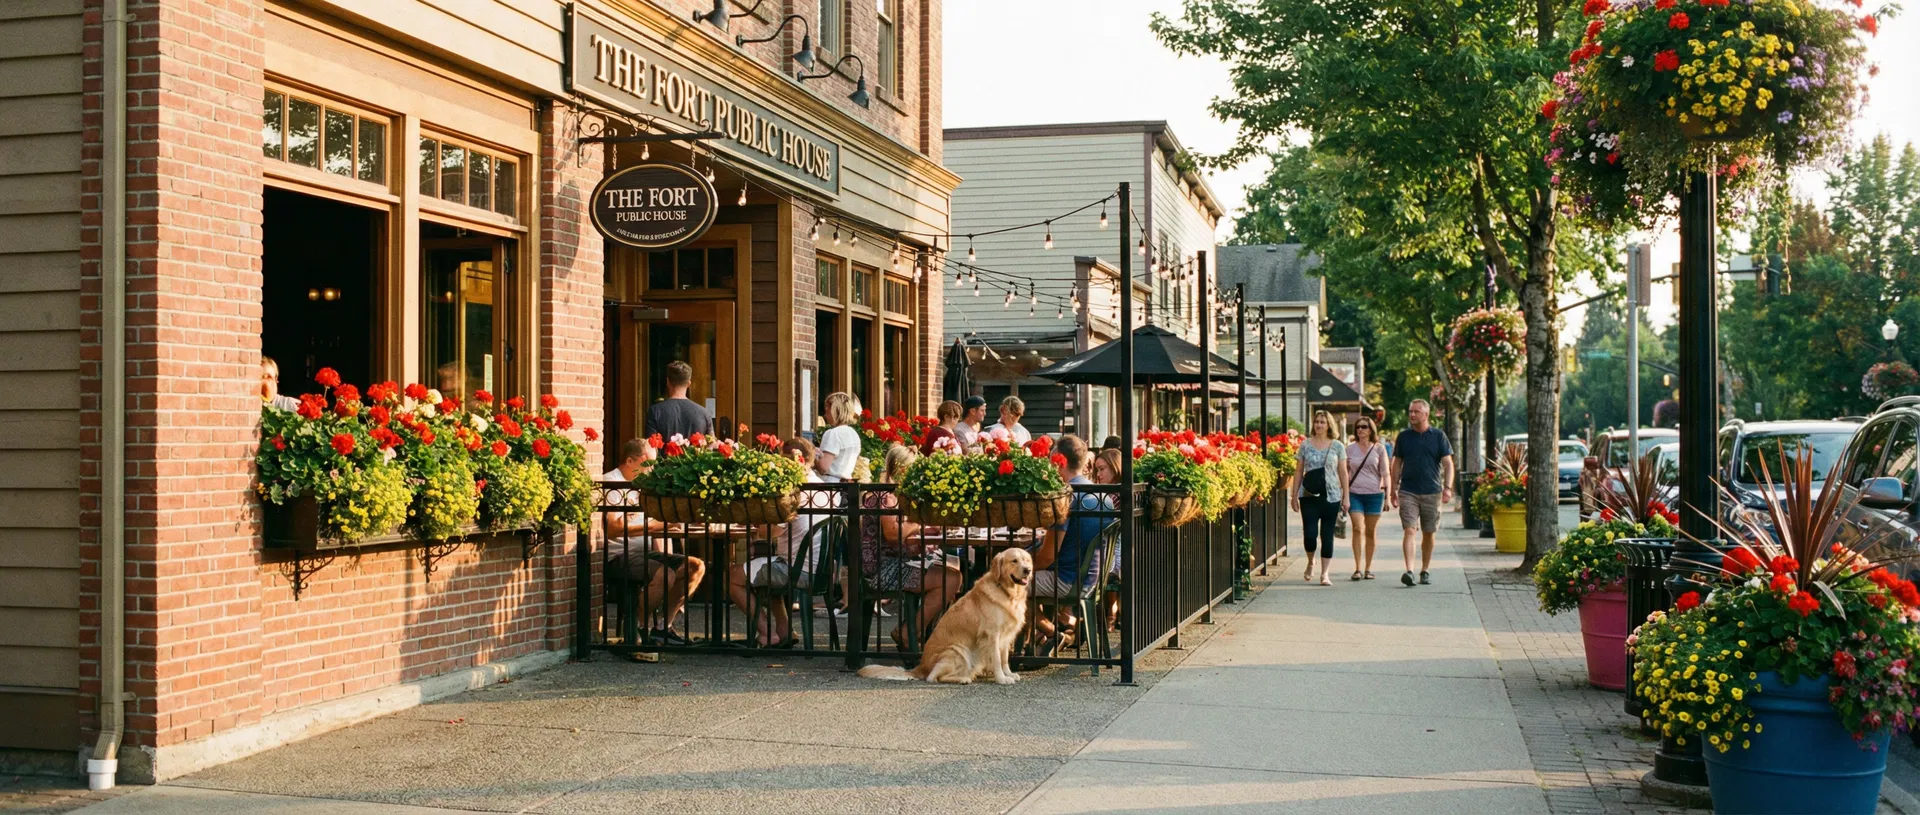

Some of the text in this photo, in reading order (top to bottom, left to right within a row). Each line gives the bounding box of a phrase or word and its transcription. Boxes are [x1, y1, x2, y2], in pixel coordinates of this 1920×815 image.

[592, 33, 832, 182] THE FORT PUBLIC HOUSE
[605, 187, 698, 209] THE FORT
[616, 210, 687, 222] PUBLIC HOUSE
